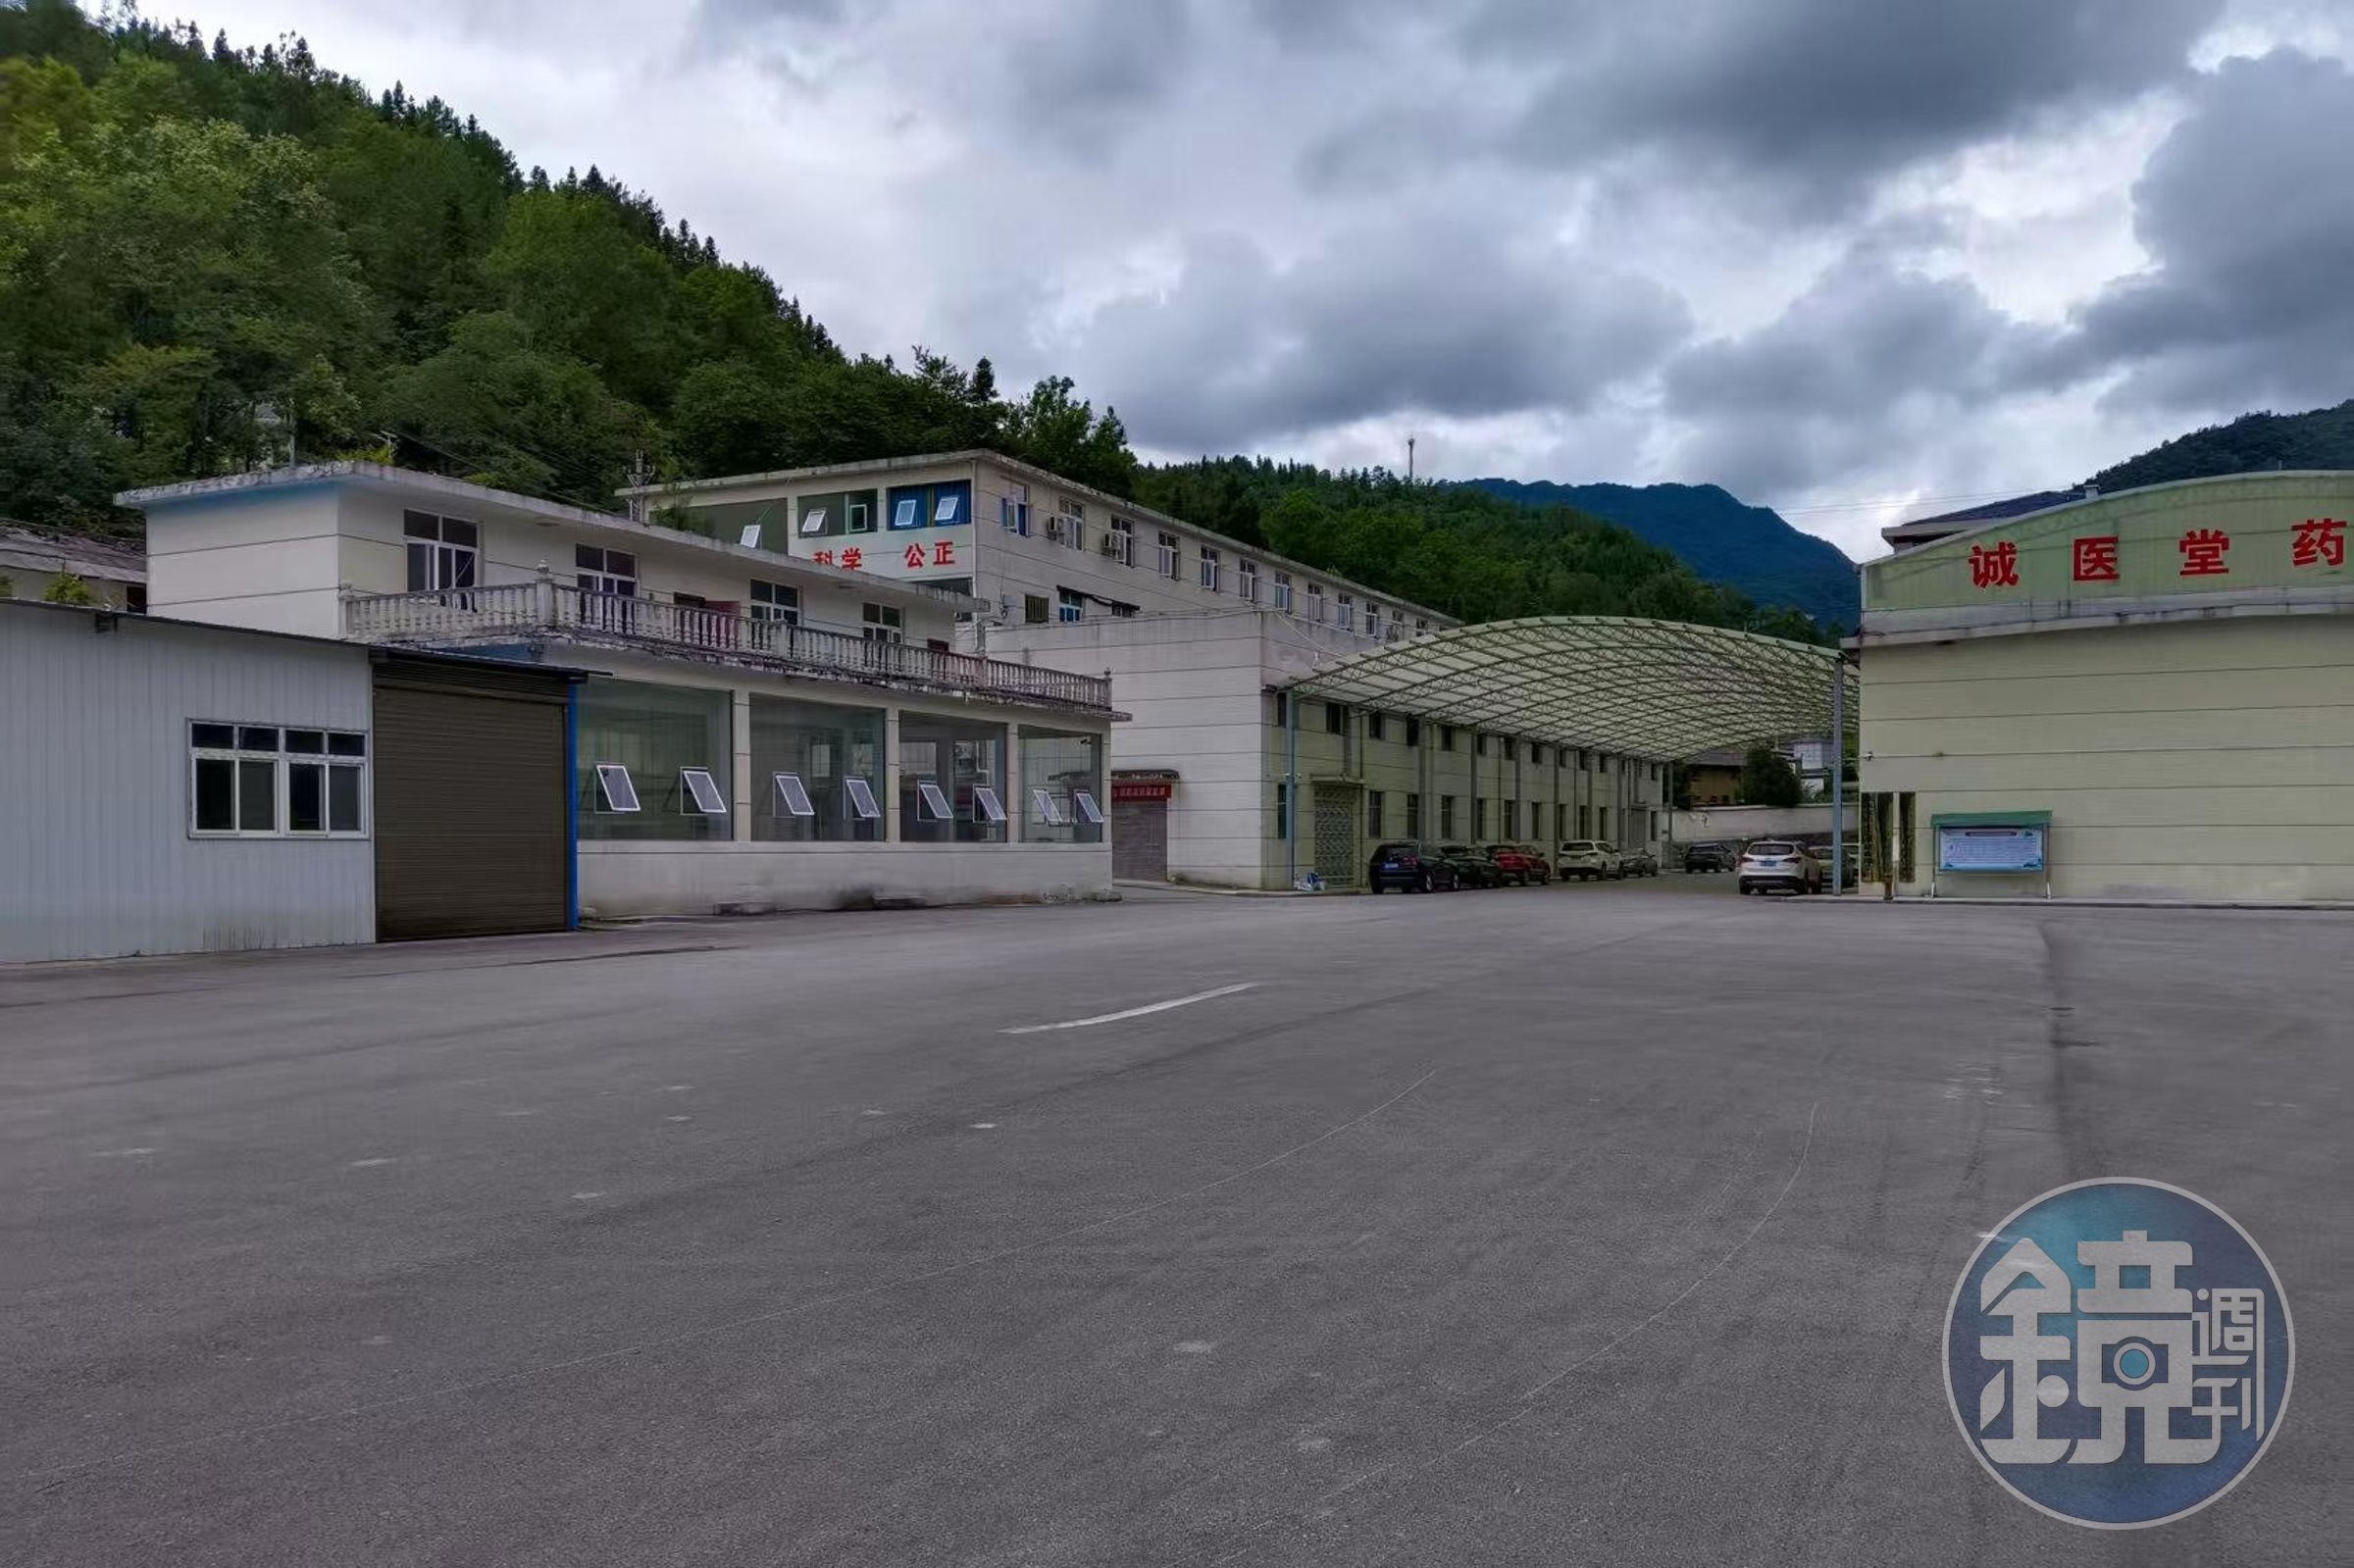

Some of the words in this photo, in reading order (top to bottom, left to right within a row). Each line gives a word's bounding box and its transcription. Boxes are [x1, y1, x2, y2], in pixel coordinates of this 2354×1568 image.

[903, 541, 956, 569] 公正
[1968, 518, 2348, 588] 诚医堂药
